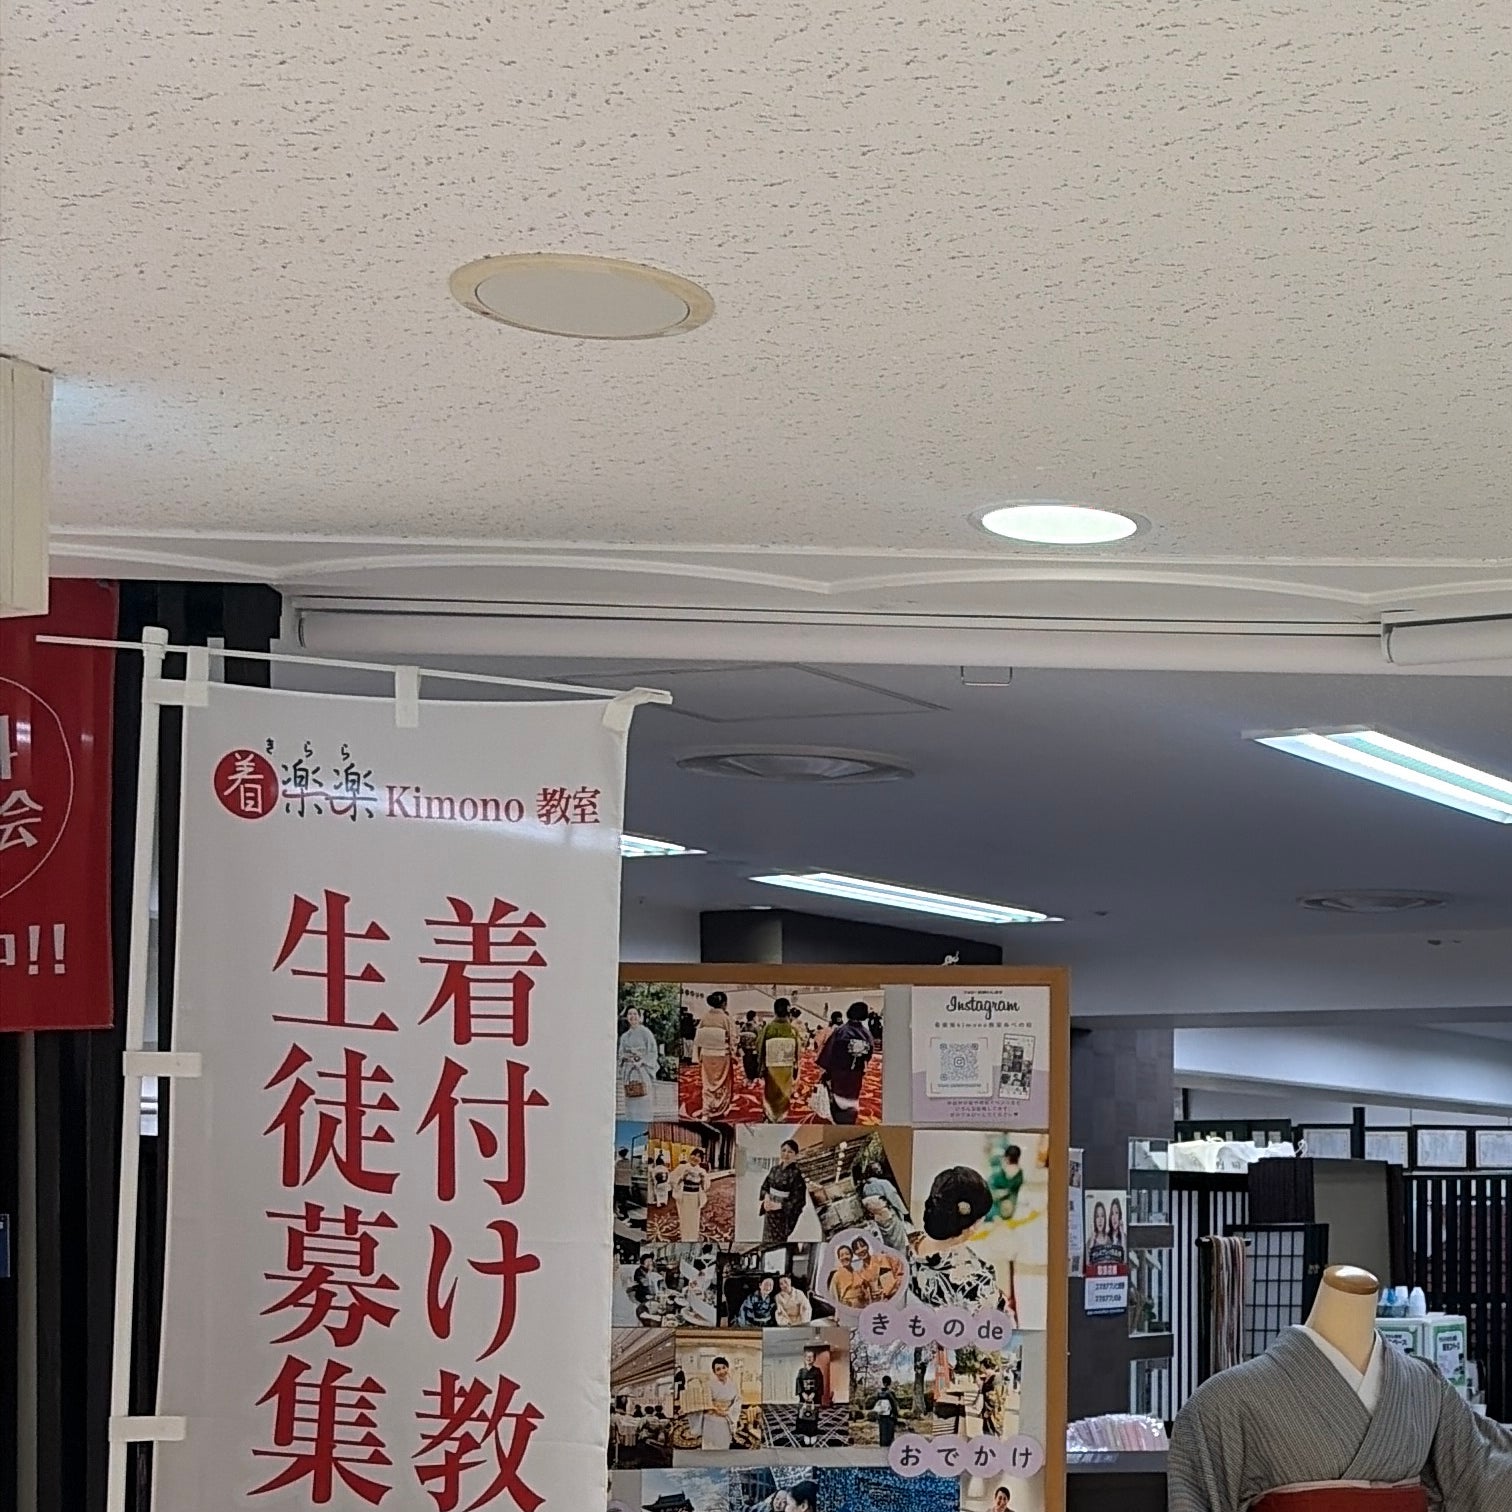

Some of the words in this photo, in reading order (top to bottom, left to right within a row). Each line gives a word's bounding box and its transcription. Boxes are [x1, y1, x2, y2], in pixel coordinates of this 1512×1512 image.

[386, 785, 525, 822] Kimono
[537, 786, 601, 825] 教室
[946, 995, 1020, 1020] Instagram
[899, 1443, 1033, 1469] おでかけ
